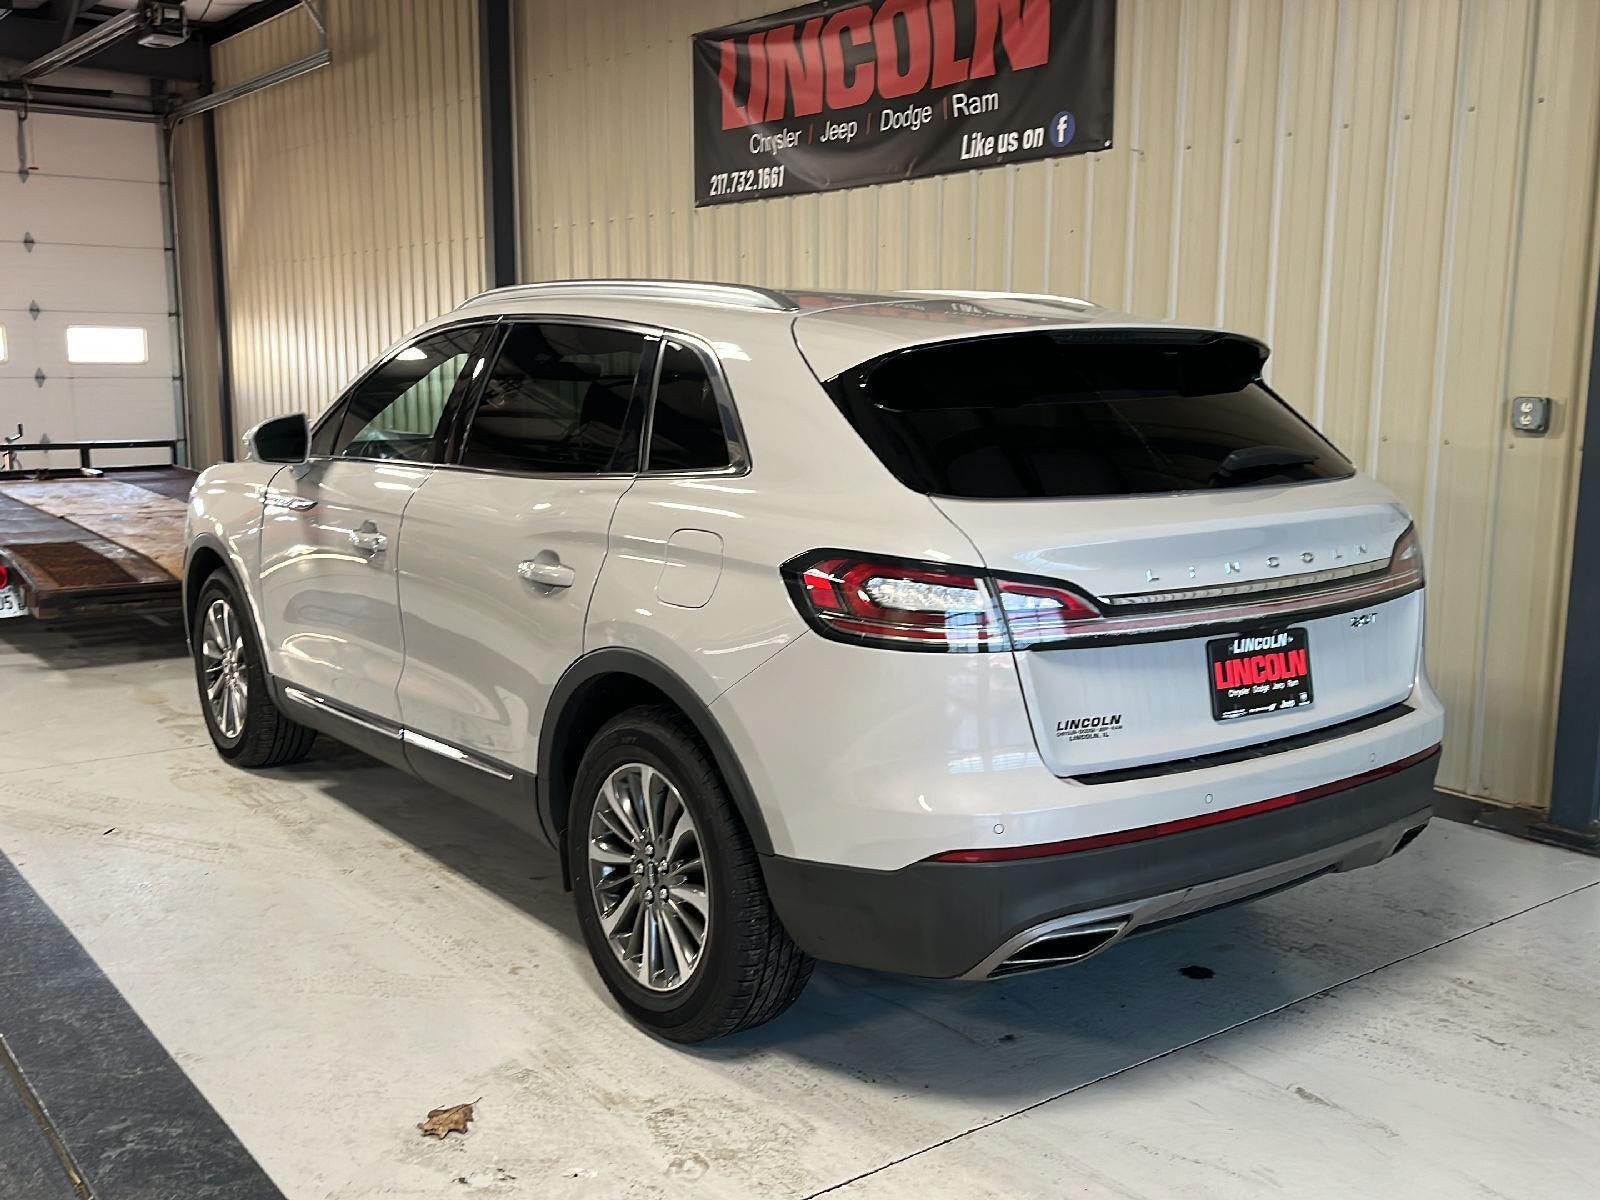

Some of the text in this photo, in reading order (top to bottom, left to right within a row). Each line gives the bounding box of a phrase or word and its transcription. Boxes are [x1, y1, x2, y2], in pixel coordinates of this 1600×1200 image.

[720, 0, 1051, 131] LINCOLN
[820, 119, 858, 143] Jeep
[880, 104, 933, 134] Dodge
[952, 92, 999, 119] Ram
[961, 130, 994, 160] Like
[997, 132, 1018, 152] us
[1023, 126, 1044, 148] on
[709, 164, 786, 196] 217.732.1661
[1233, 633, 1288, 654] LINCOLN
[1215, 649, 1307, 690] LINCOLN
[1057, 714, 1122, 731] LINCOLN
